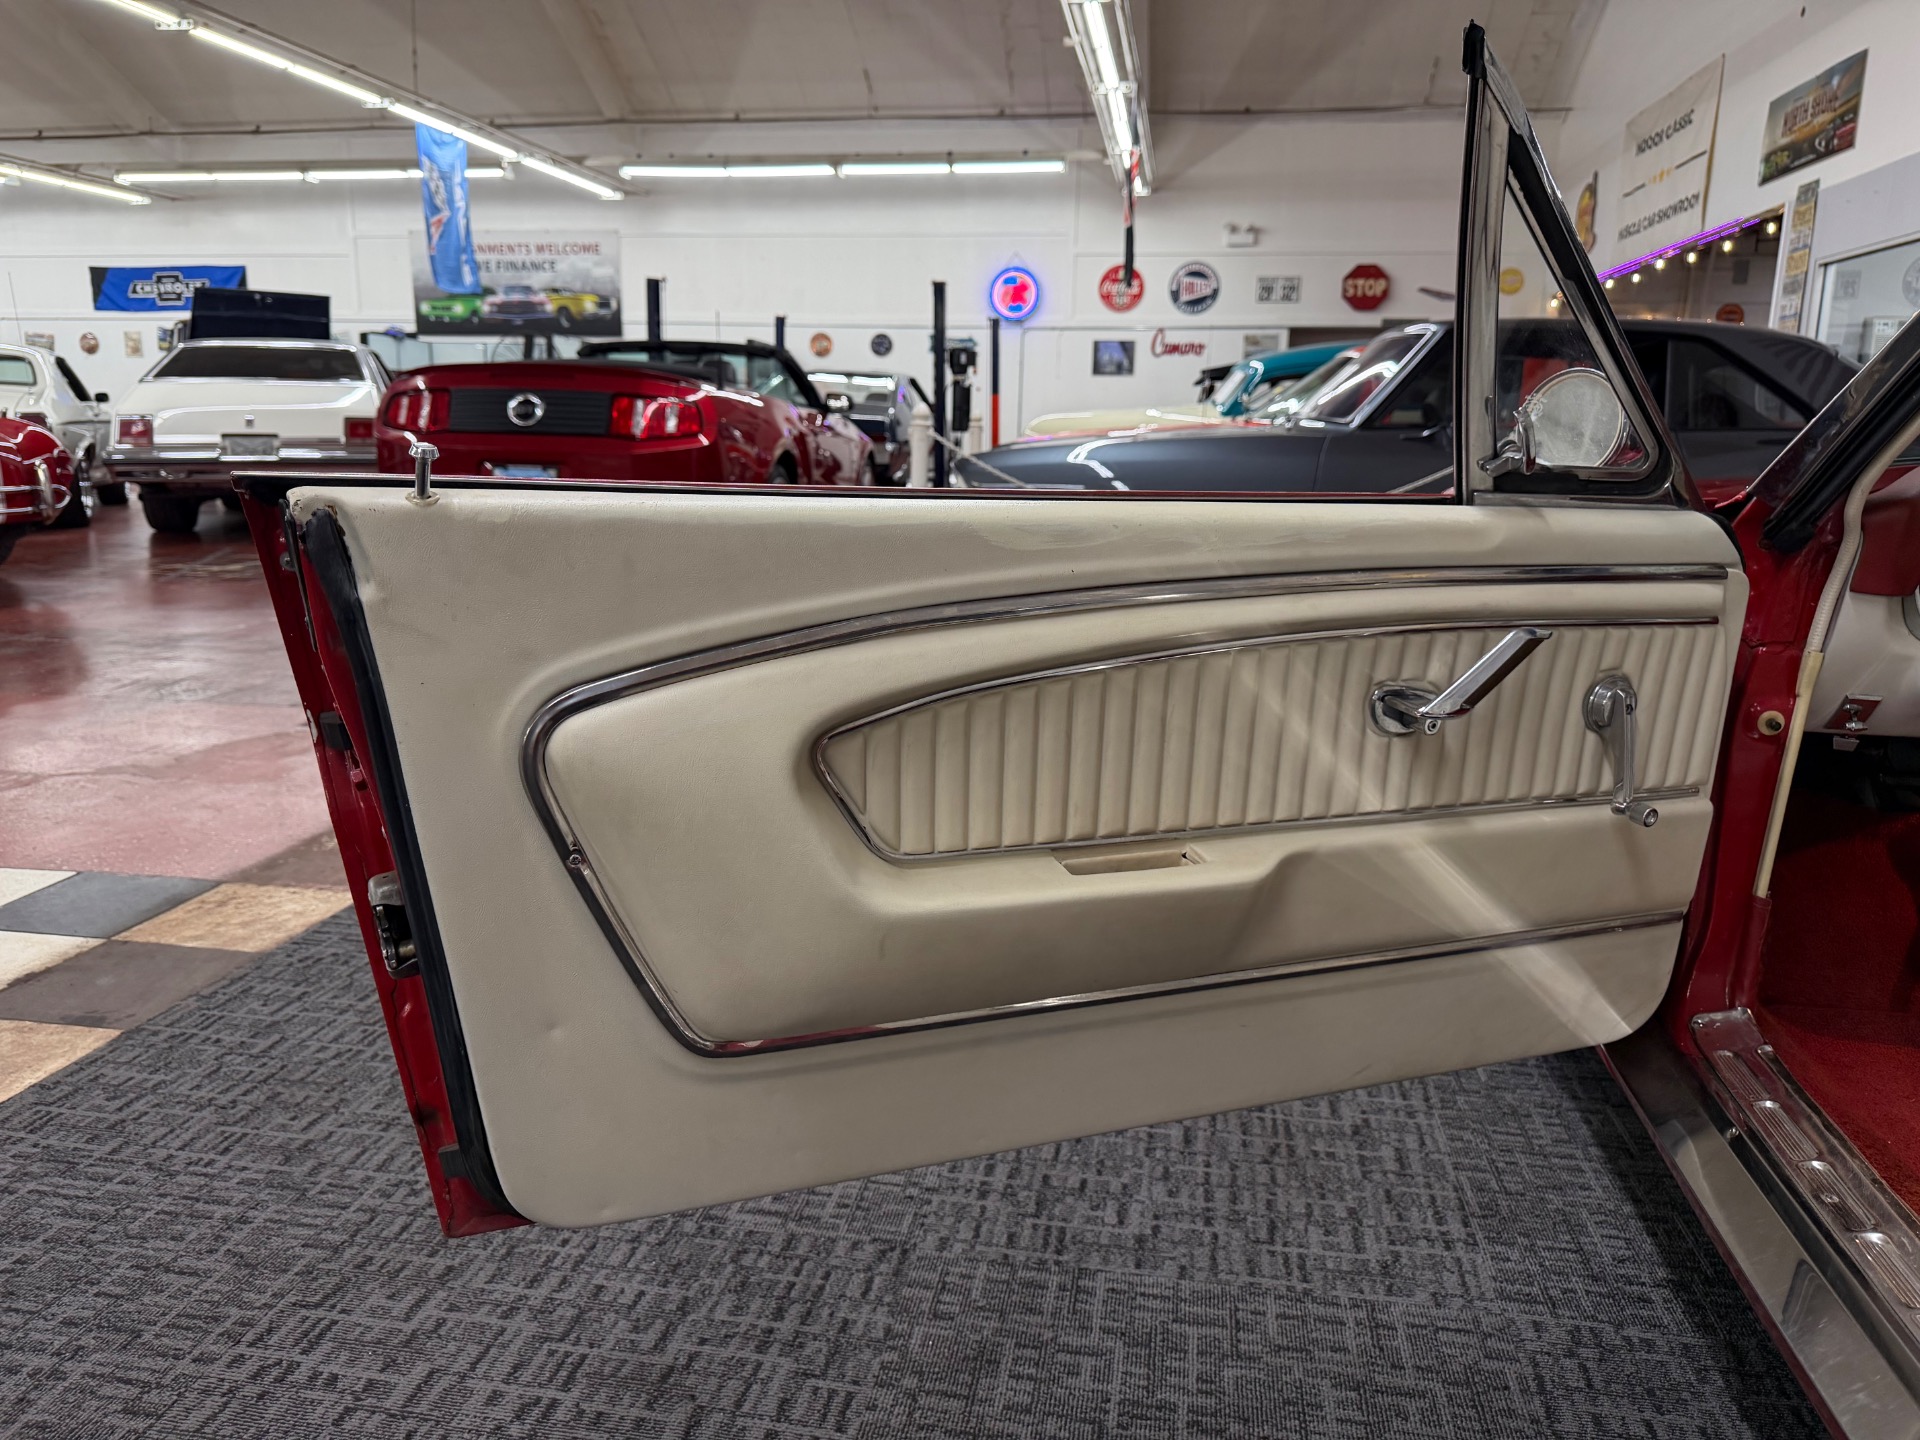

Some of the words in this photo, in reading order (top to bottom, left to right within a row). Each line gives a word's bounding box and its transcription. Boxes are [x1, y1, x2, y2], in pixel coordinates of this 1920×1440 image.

[472, 242, 530, 256] NMENTS
[535, 242, 600, 256] WELCOME
[495, 258, 558, 274] FINANCE
[1344, 278, 1388, 298] STOP
[1151, 327, 1206, 357] Camaro
